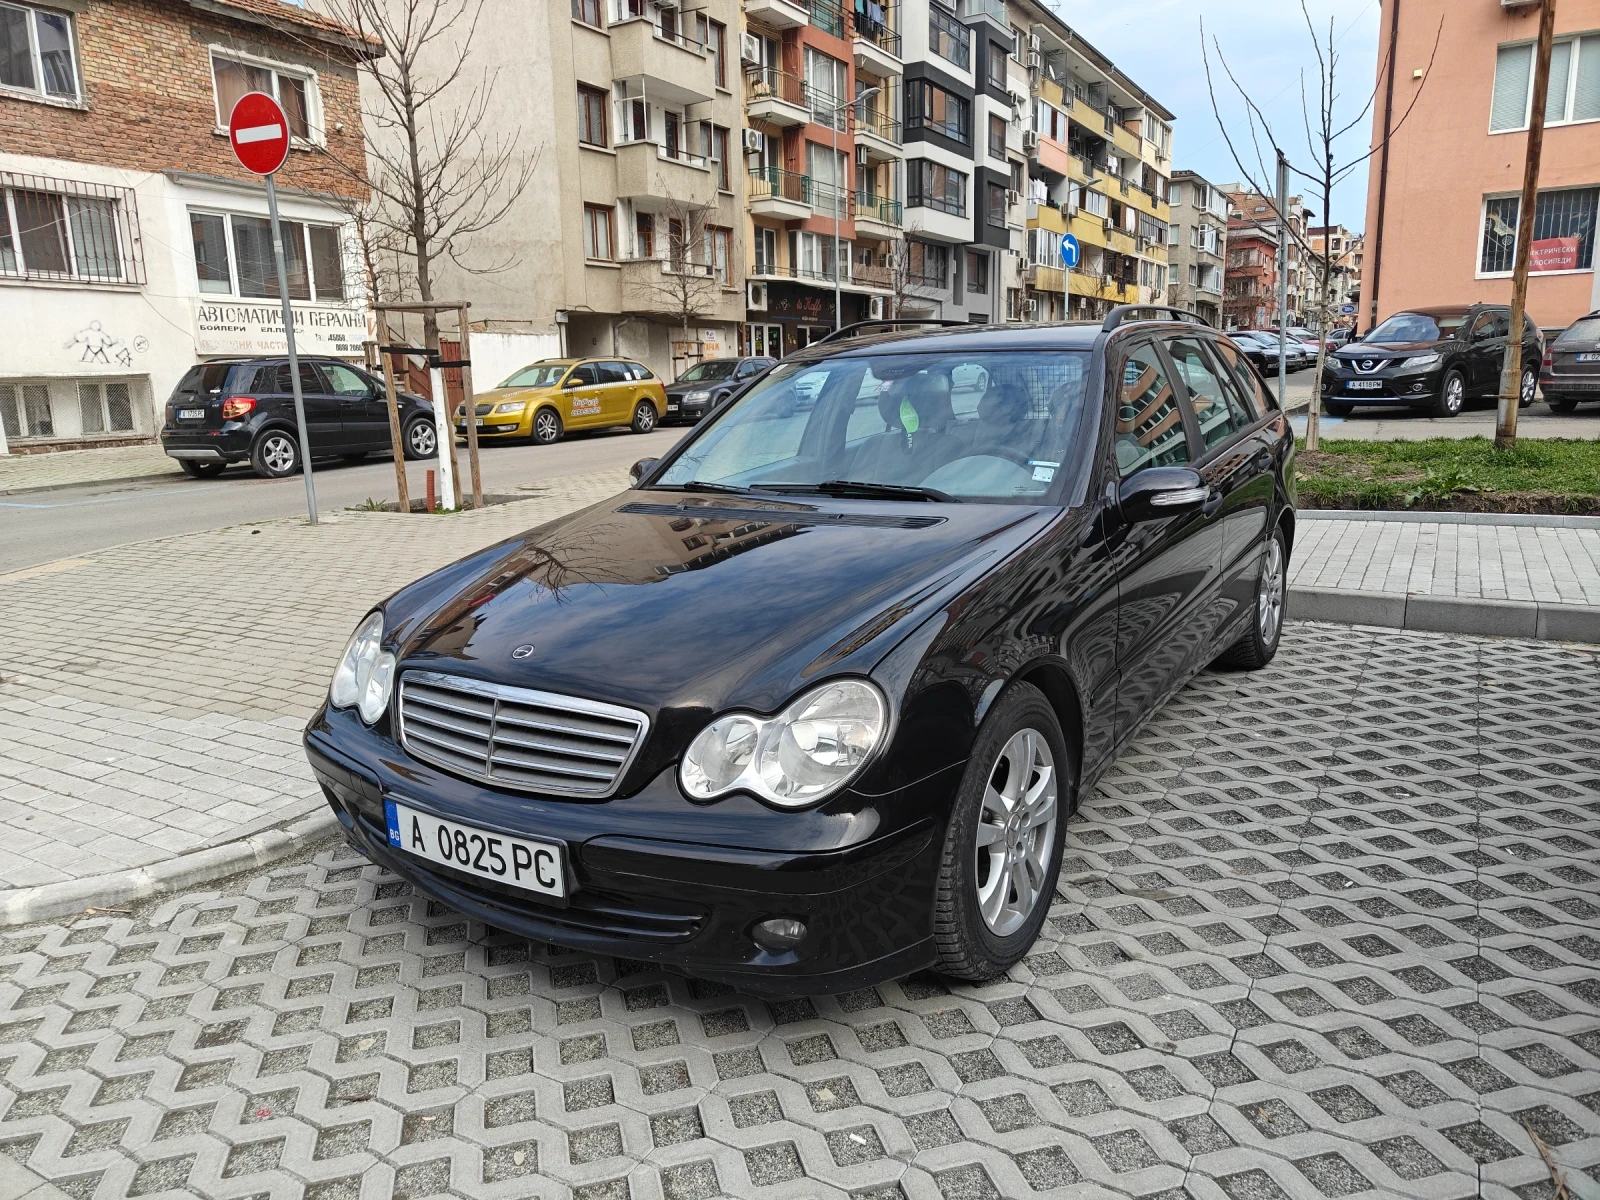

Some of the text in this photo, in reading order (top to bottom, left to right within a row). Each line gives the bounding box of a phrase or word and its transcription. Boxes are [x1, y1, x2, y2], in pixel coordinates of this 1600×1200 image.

[1530, 247, 1576, 256] ЕКТРИЧЕСКИ
[1529, 257, 1572, 266] ЕЛОСИПЕДИ
[200, 324, 246, 332] БОЙЛЕРИ
[389, 828, 400, 841] BG
[412, 815, 426, 852] A
